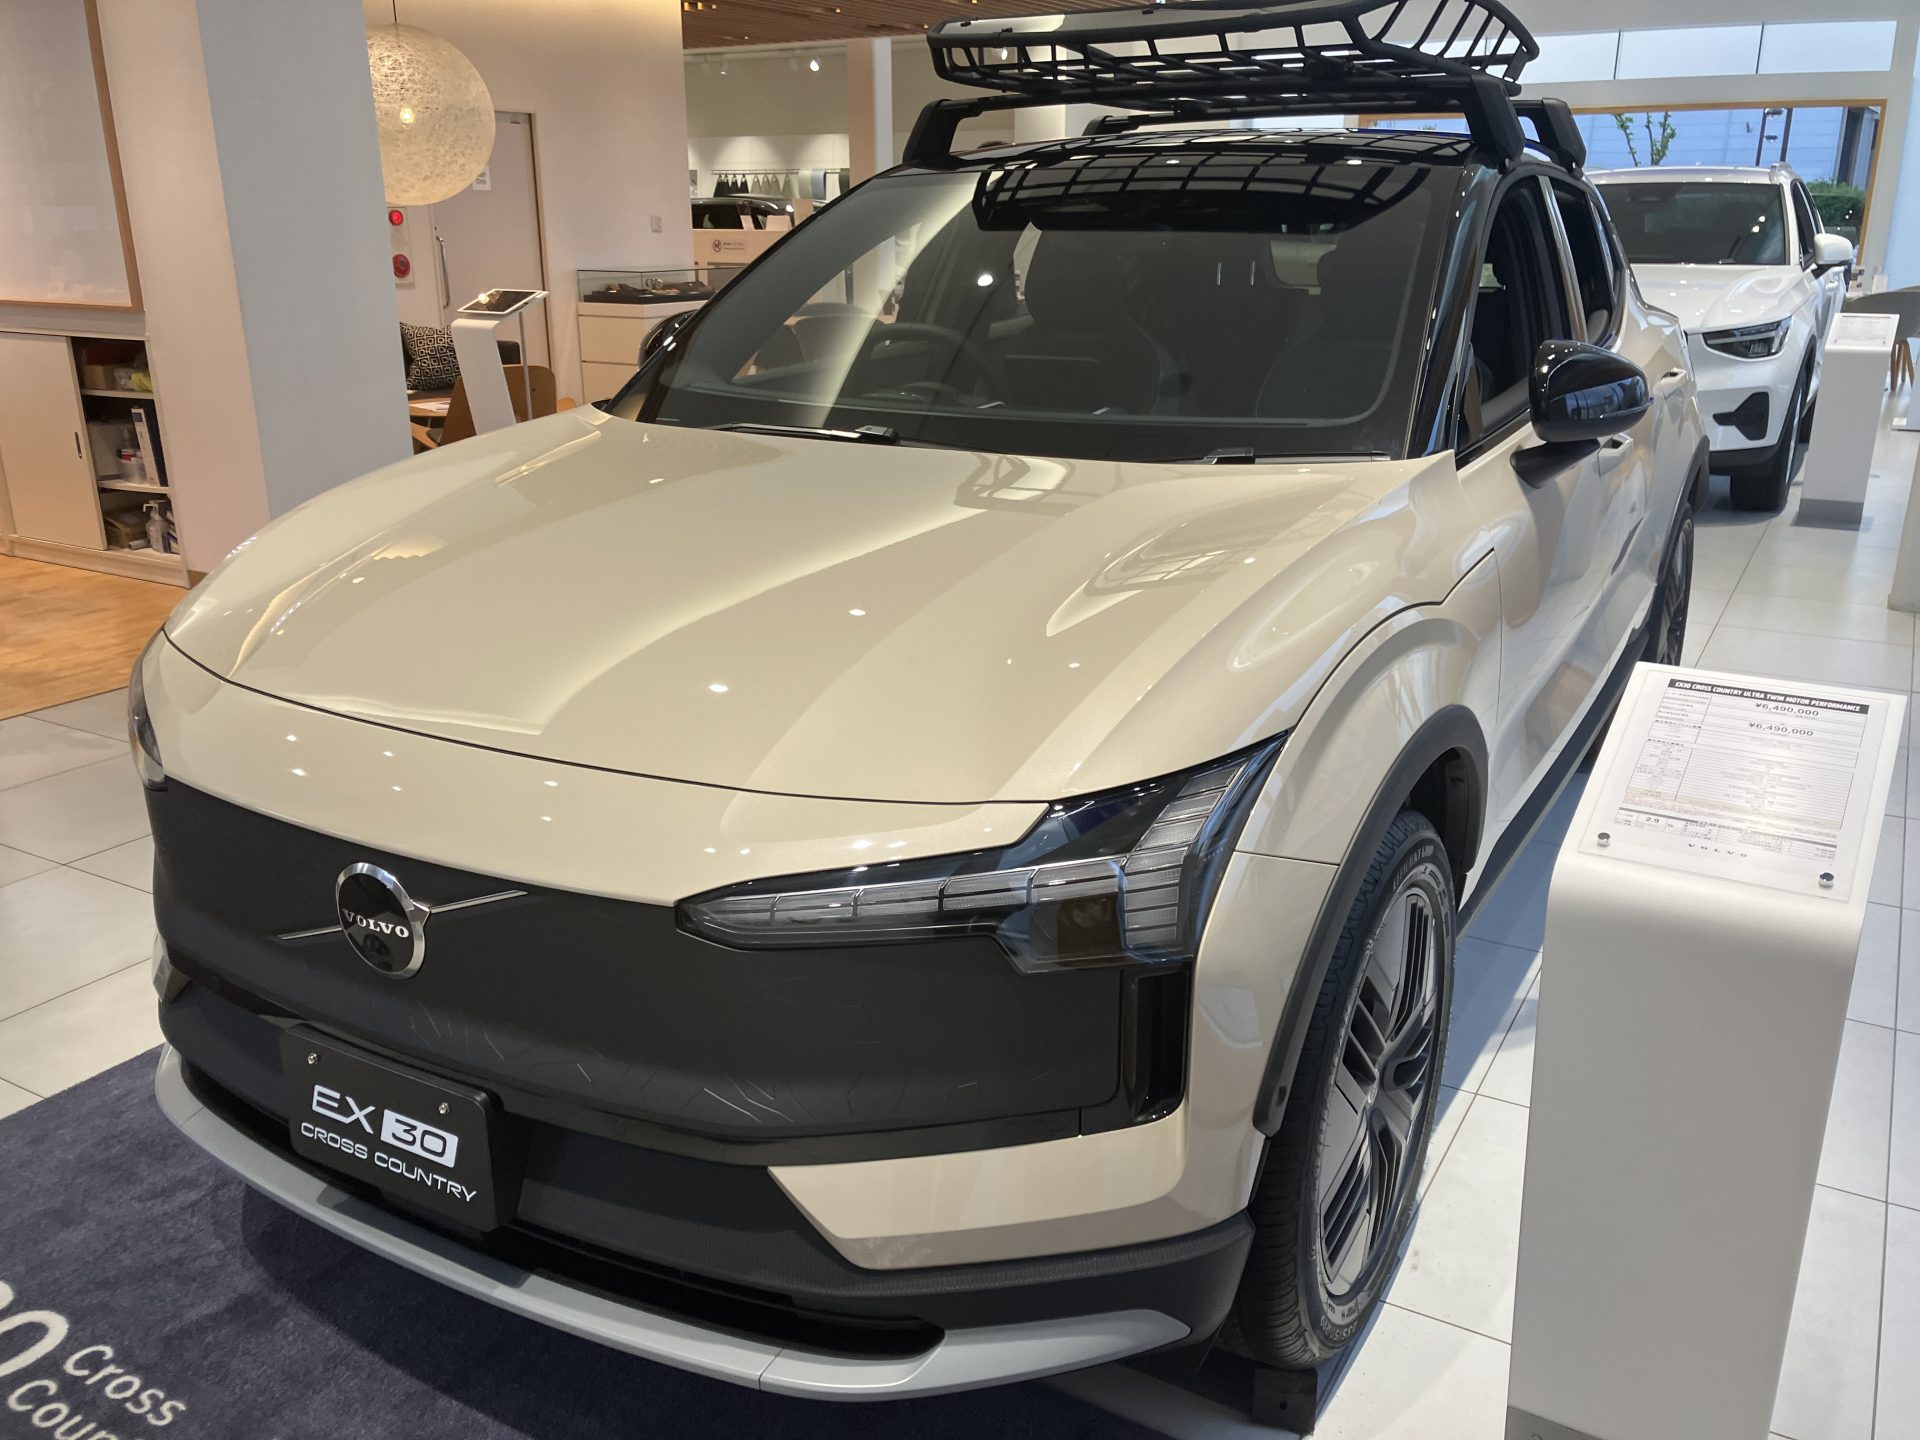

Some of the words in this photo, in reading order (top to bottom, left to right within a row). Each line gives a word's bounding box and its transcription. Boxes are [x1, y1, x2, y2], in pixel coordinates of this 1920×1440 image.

[1692, 683, 1712, 692] CROSS
[1712, 686, 1743, 696] COUNTRY
[1743, 690, 1765, 699] ULTRA
[1766, 693, 1785, 702] TWIN
[1785, 696, 1810, 705] MOTOR
[1811, 700, 1861, 712] PERFORMANCE
[1755, 702, 1819, 717] ¥6,490,000
[1748, 721, 1814, 737] ¥6,490,000
[342, 908, 410, 939] VOLVO
[301, 1121, 368, 1160] CROSS
[374, 1151, 478, 1203] COUNTRY
[63, 1344, 187, 1427] Cross
